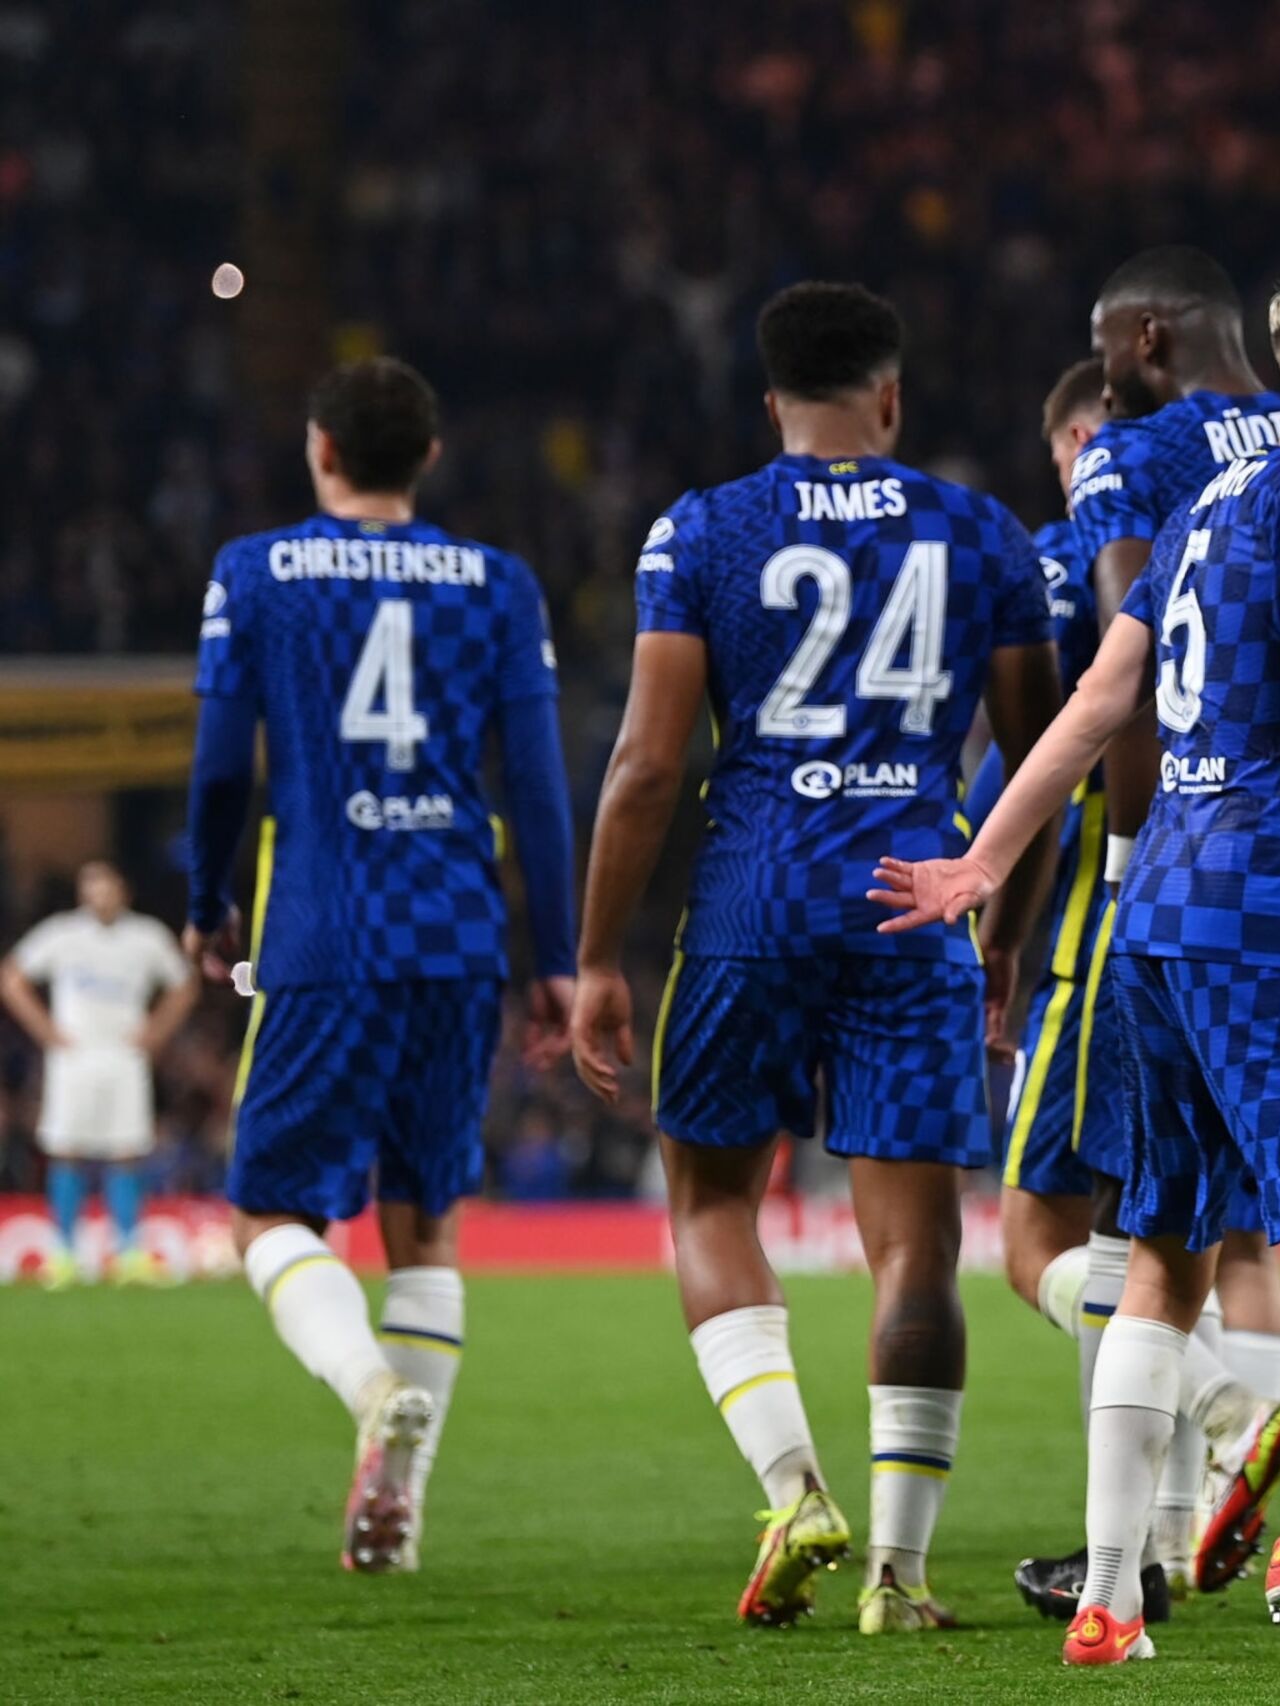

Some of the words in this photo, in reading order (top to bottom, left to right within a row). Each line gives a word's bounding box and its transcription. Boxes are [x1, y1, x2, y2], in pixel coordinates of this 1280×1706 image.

[795, 478, 907, 521] JAMES
[268, 540, 485, 587] CHRISTENSEN
[340, 598, 428, 773] 4
[756, 541, 953, 737] 24
[1155, 529, 1212, 733] 5
[843, 762, 918, 786] PLAN
